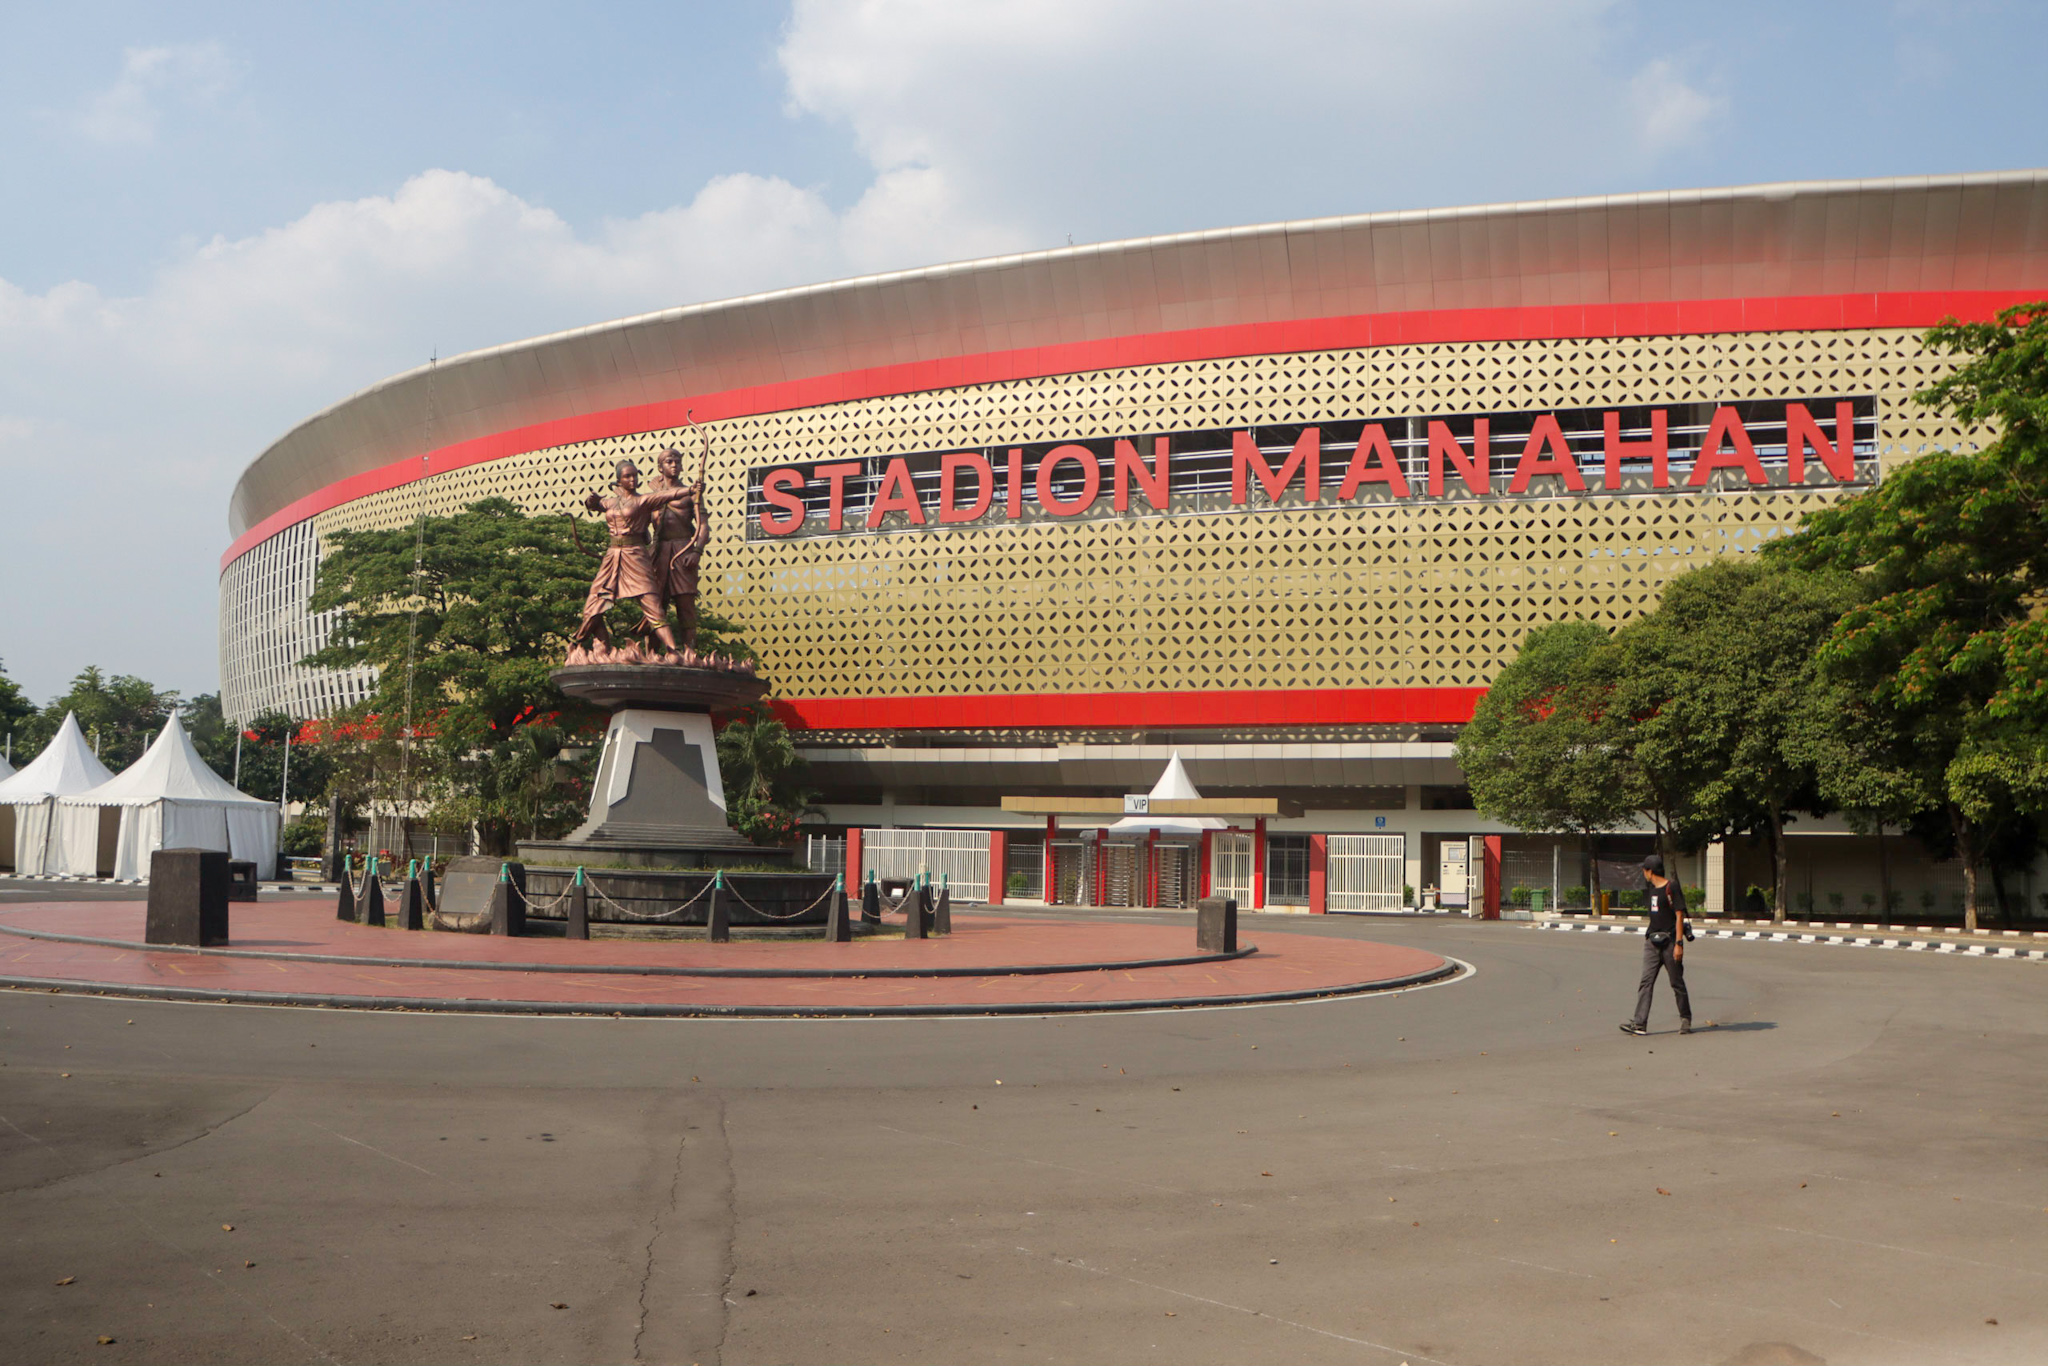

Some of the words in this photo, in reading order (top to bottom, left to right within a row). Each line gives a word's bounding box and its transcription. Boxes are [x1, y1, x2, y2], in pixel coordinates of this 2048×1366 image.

[760, 436, 1170, 535] STADION
[1231, 400, 1856, 504] MANAHAN
[1133, 799, 1147, 810] VIP
